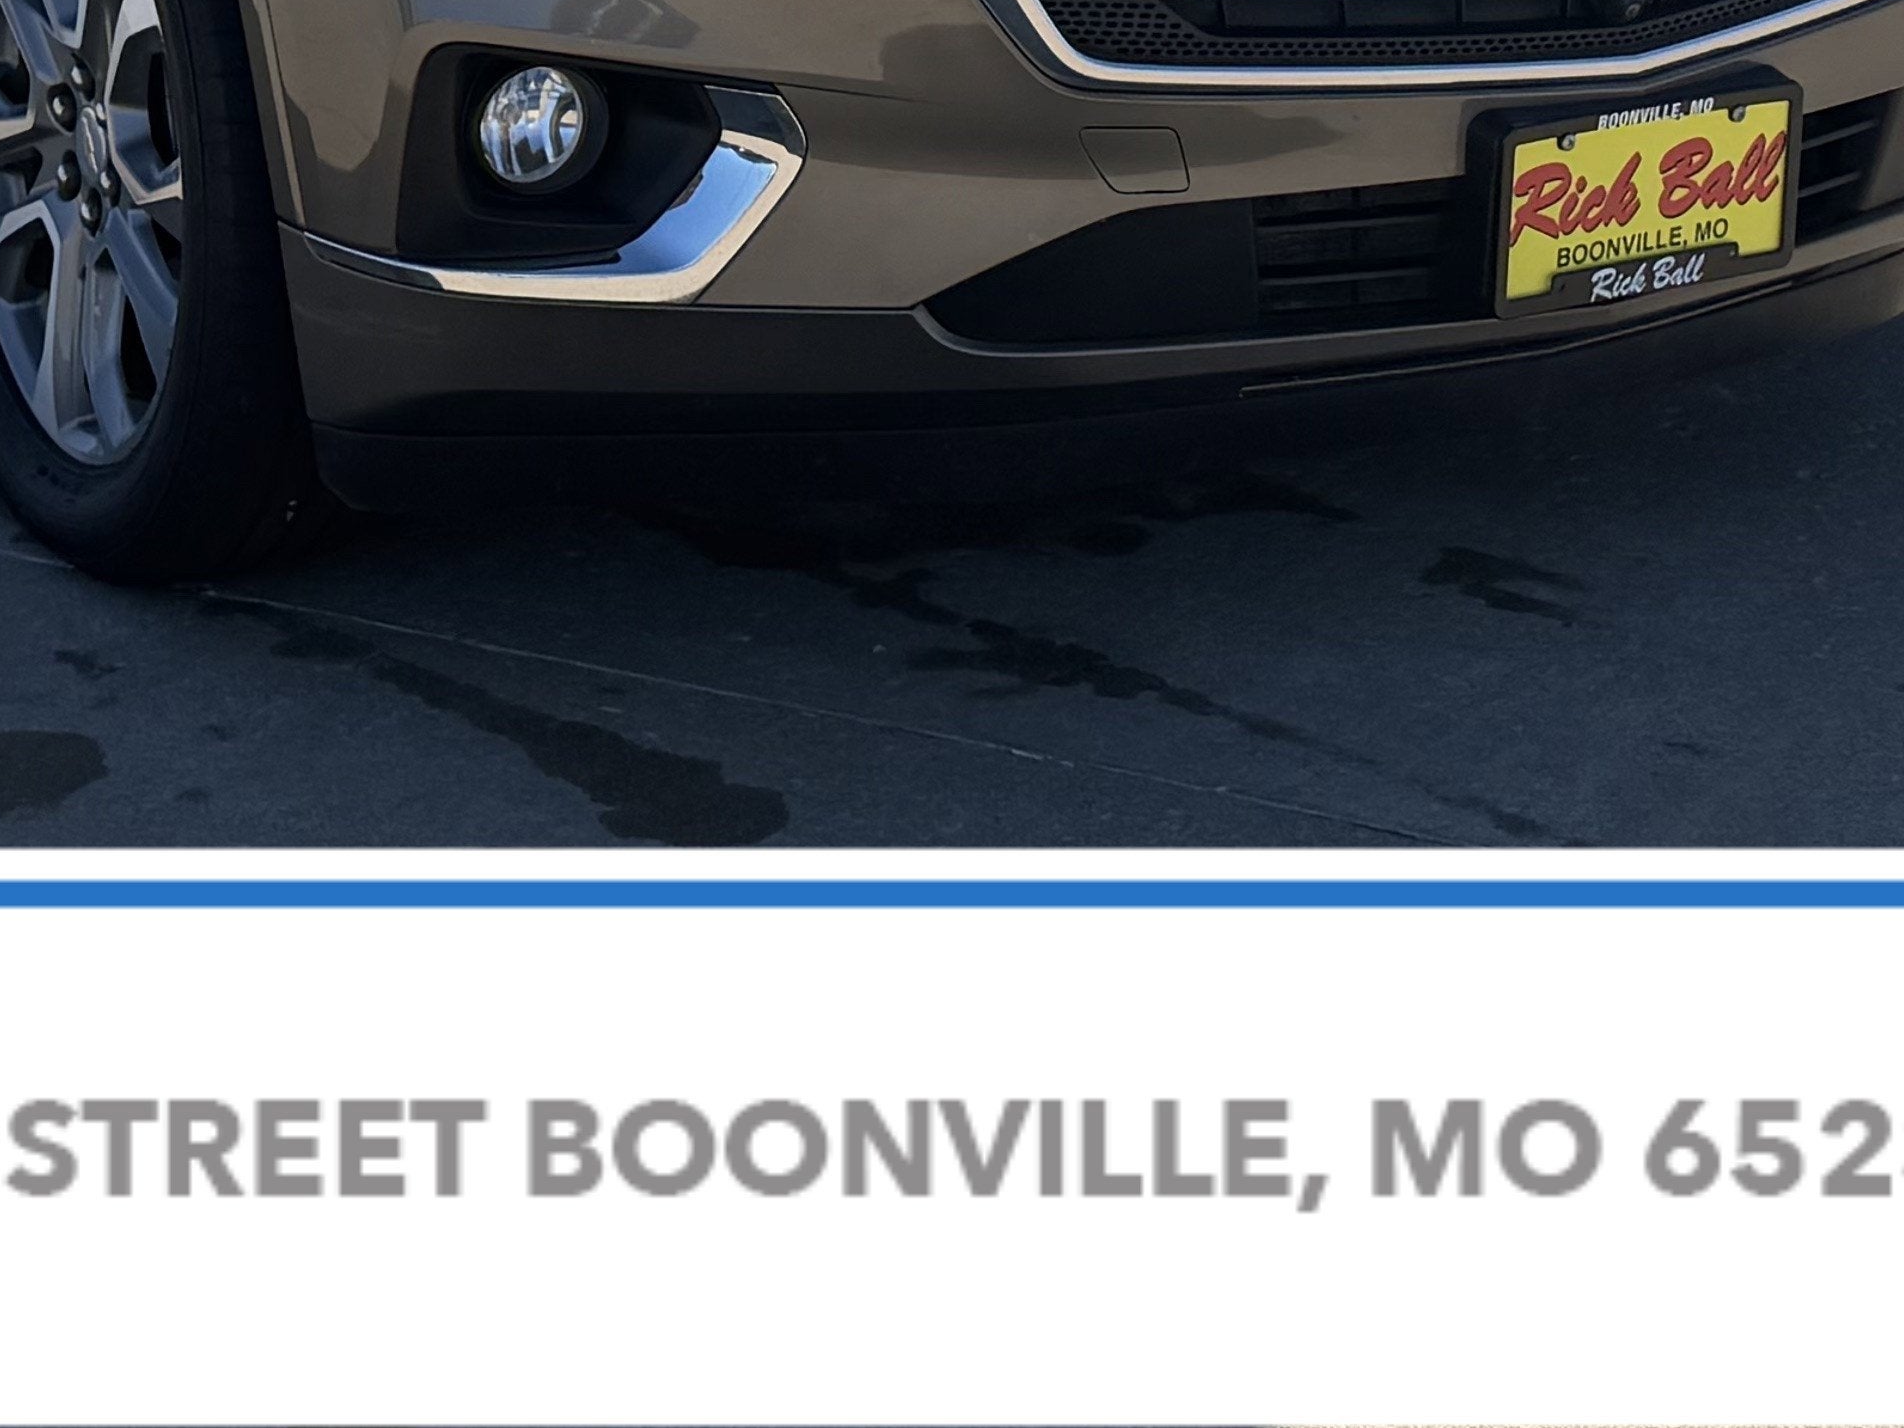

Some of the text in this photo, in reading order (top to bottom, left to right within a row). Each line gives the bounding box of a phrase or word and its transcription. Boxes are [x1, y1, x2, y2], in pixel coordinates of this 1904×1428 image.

[1597, 96, 1715, 131] BOONVILLE, MO
[1509, 130, 1787, 247] Rick Ball
[1556, 218, 1729, 268] BOONVILLE, MO
[1590, 253, 1706, 303] Rick Ball
